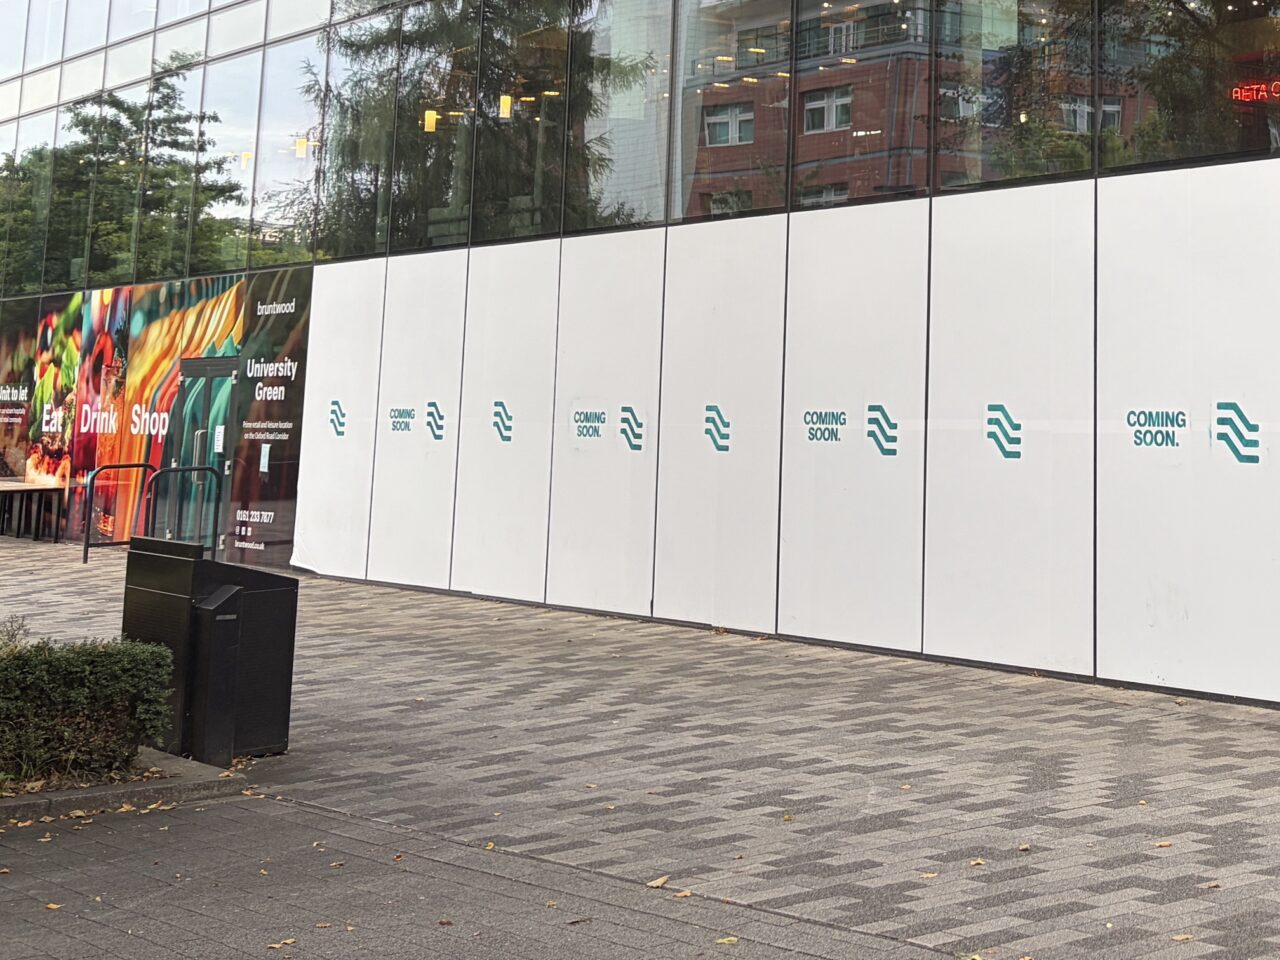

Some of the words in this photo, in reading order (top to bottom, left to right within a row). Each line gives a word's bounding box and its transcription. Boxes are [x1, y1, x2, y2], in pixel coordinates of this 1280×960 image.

[257, 298, 296, 316] bruntwood
[246, 356, 298, 381] University
[12, 386, 19, 401] to
[19, 385, 28, 401] let
[255, 381, 286, 401] Green
[389, 408, 415, 420] COMING
[573, 411, 606, 424] COMING
[803, 411, 847, 426] COMING
[1126, 410, 1187, 428] COMING
[42, 403, 64, 433] Eat
[80, 403, 118, 434] Drink
[131, 403, 170, 443] Shop
[391, 420, 411, 432] SOON.
[576, 424, 602, 438] SOON.
[807, 426, 841, 442] SOON.
[1133, 429, 1180, 447] SOON.
